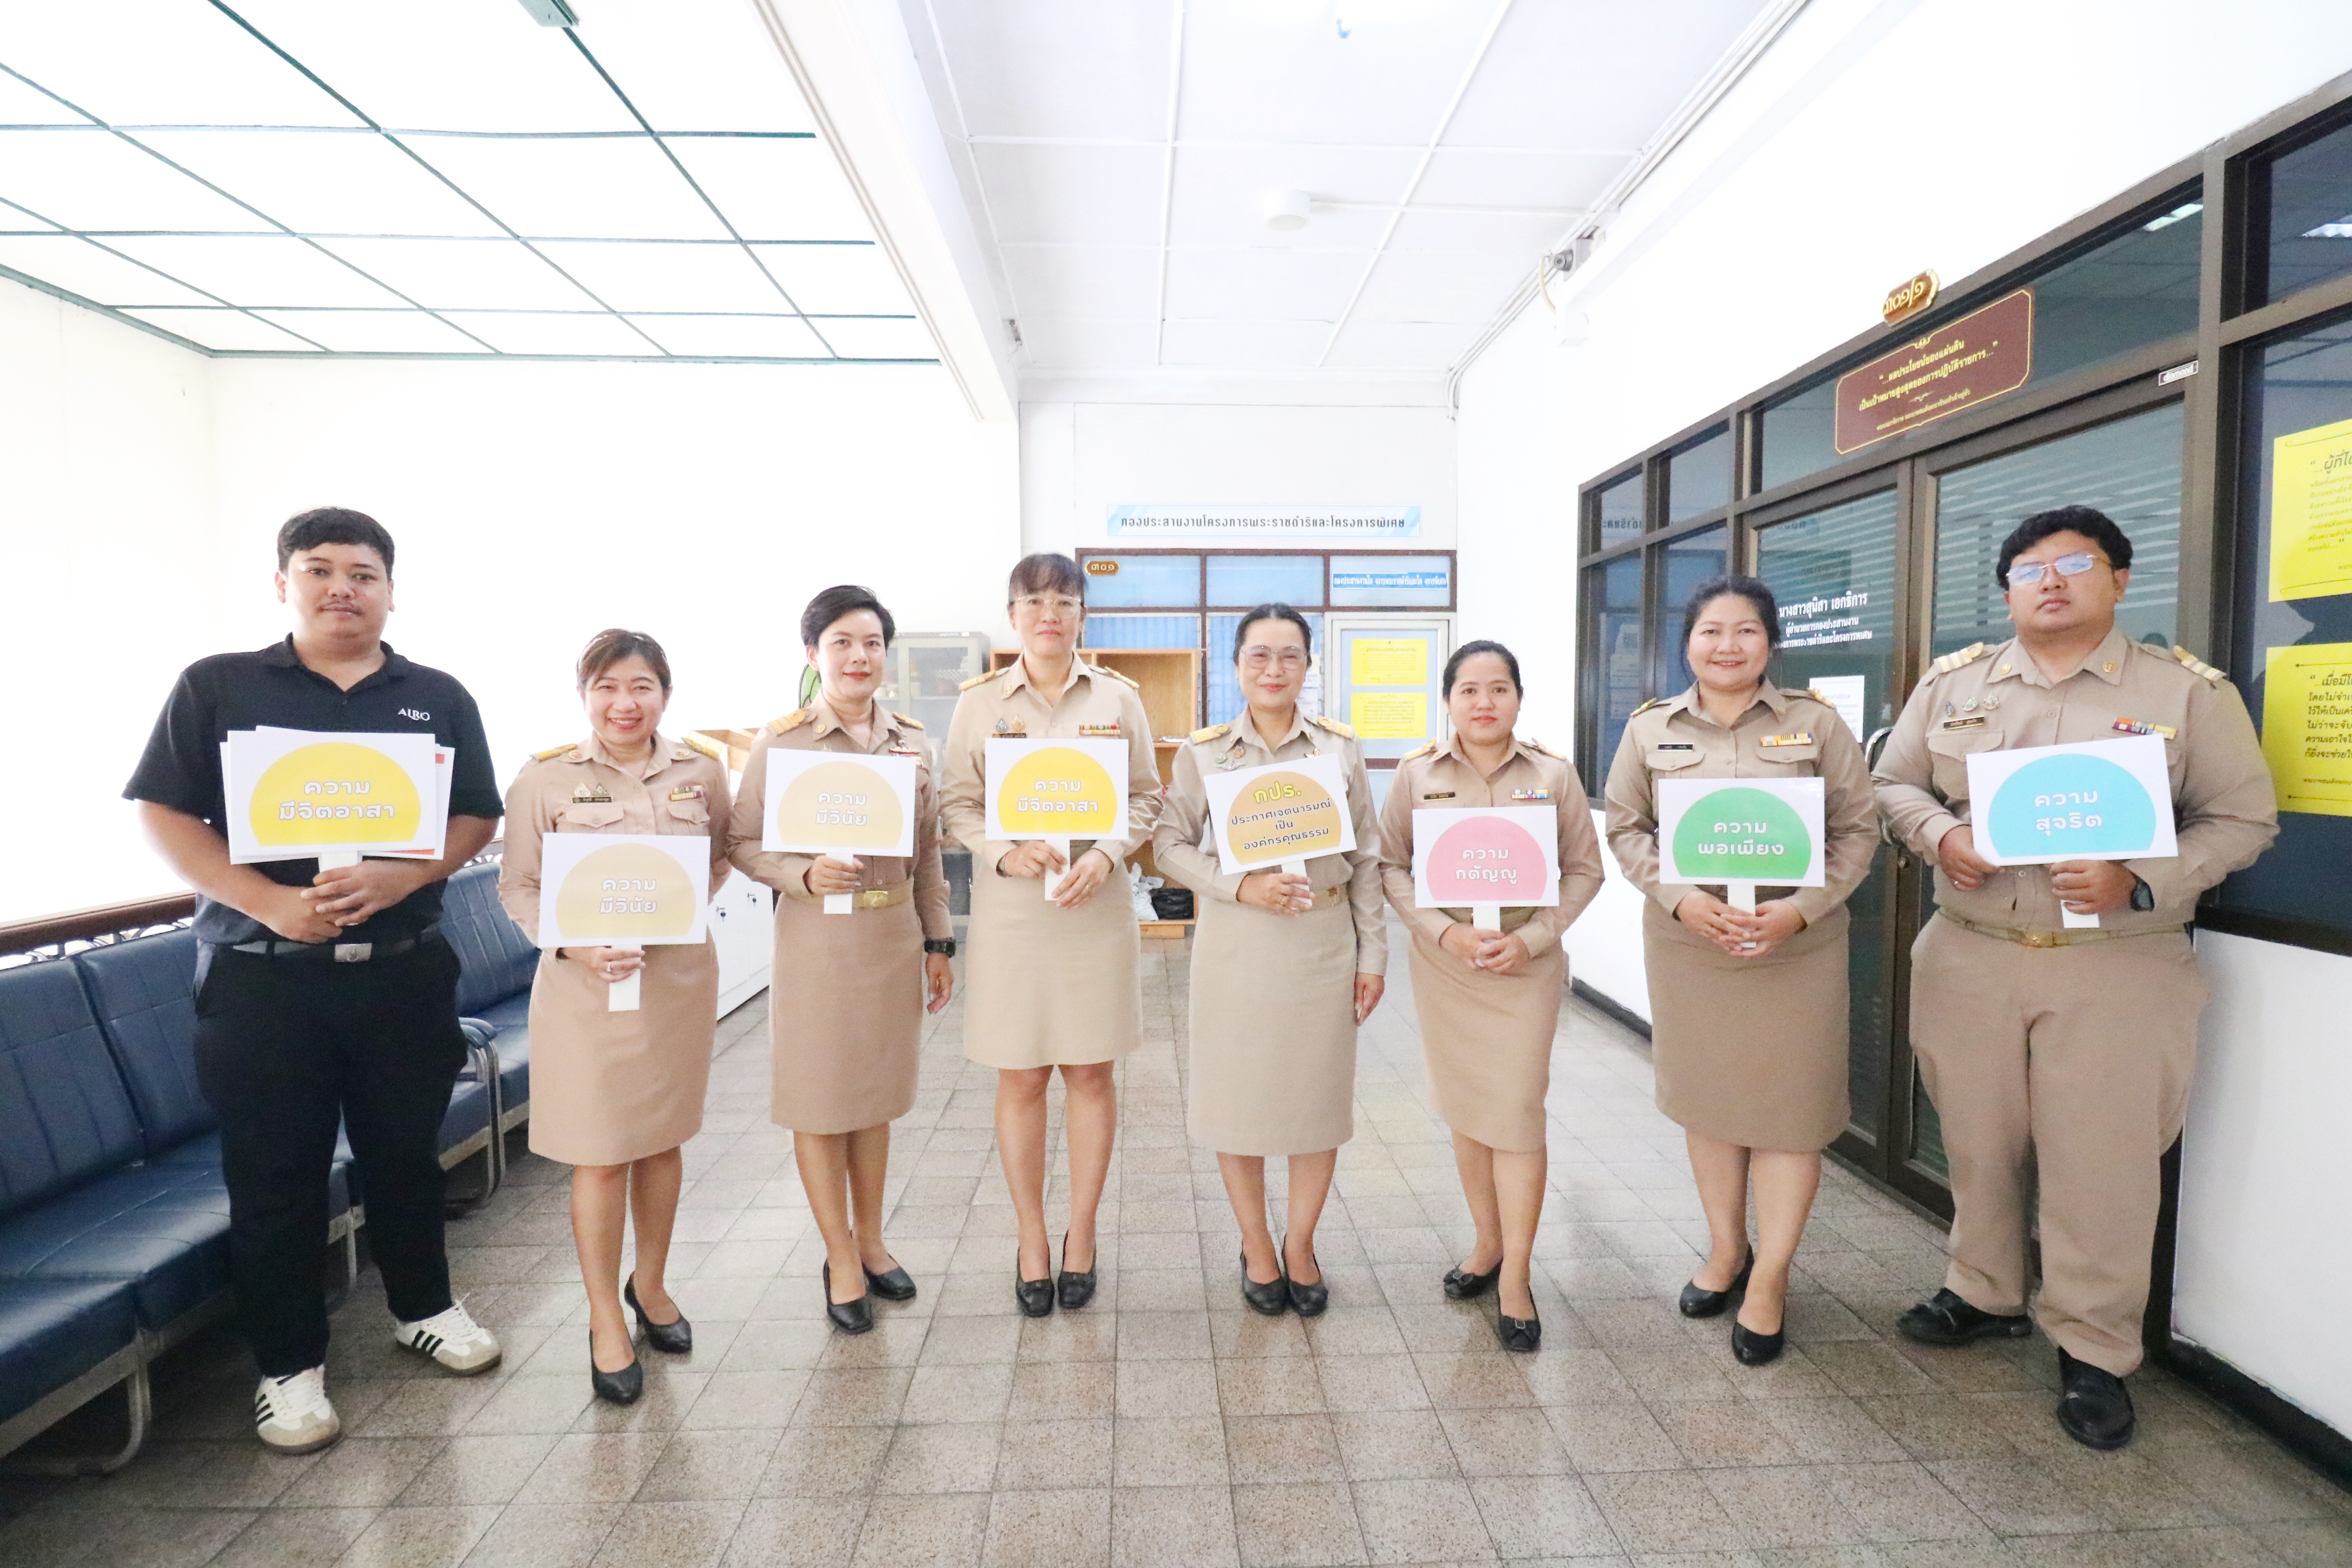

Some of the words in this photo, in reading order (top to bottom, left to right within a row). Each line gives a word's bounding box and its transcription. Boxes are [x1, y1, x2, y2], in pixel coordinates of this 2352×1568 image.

[1121, 514, 1406, 528] กองประสานงานโครงการพระราชดำริและโครงการพิเศษ
[1091, 563, 1115, 571] ๓๐๑
[1779, 596, 1828, 619] นางสาวสุนิสา
[1831, 590, 1867, 610] เอกธิการ
[398, 708, 430, 721] ALRO
[303, 780, 371, 795] ความ
[1034, 780, 1082, 792] ความ
[1253, 781, 1302, 804] กปร.
[818, 792, 867, 806] ความ
[1017, 795, 1099, 813] มีจิตอาสา
[2034, 790, 2099, 807] ความ
[278, 799, 396, 821] มีจิตอาสา
[815, 809, 867, 826] มีวินัย
[1231, 798, 1331, 825] ประกาศเจตนารมณ์
[1275, 820, 1294, 831] เป็น
[1714, 822, 1768, 834] ความ
[2036, 811, 2102, 837] สุจริต
[1243, 828, 1329, 850] องค์กรคุณธรรม
[1698, 839, 1785, 856] พอเพียง
[1462, 848, 1509, 860] ความ
[1455, 864, 1517, 885] กตัญญู
[602, 878, 656, 891] ความ
[599, 896, 657, 914] มีวินัย
